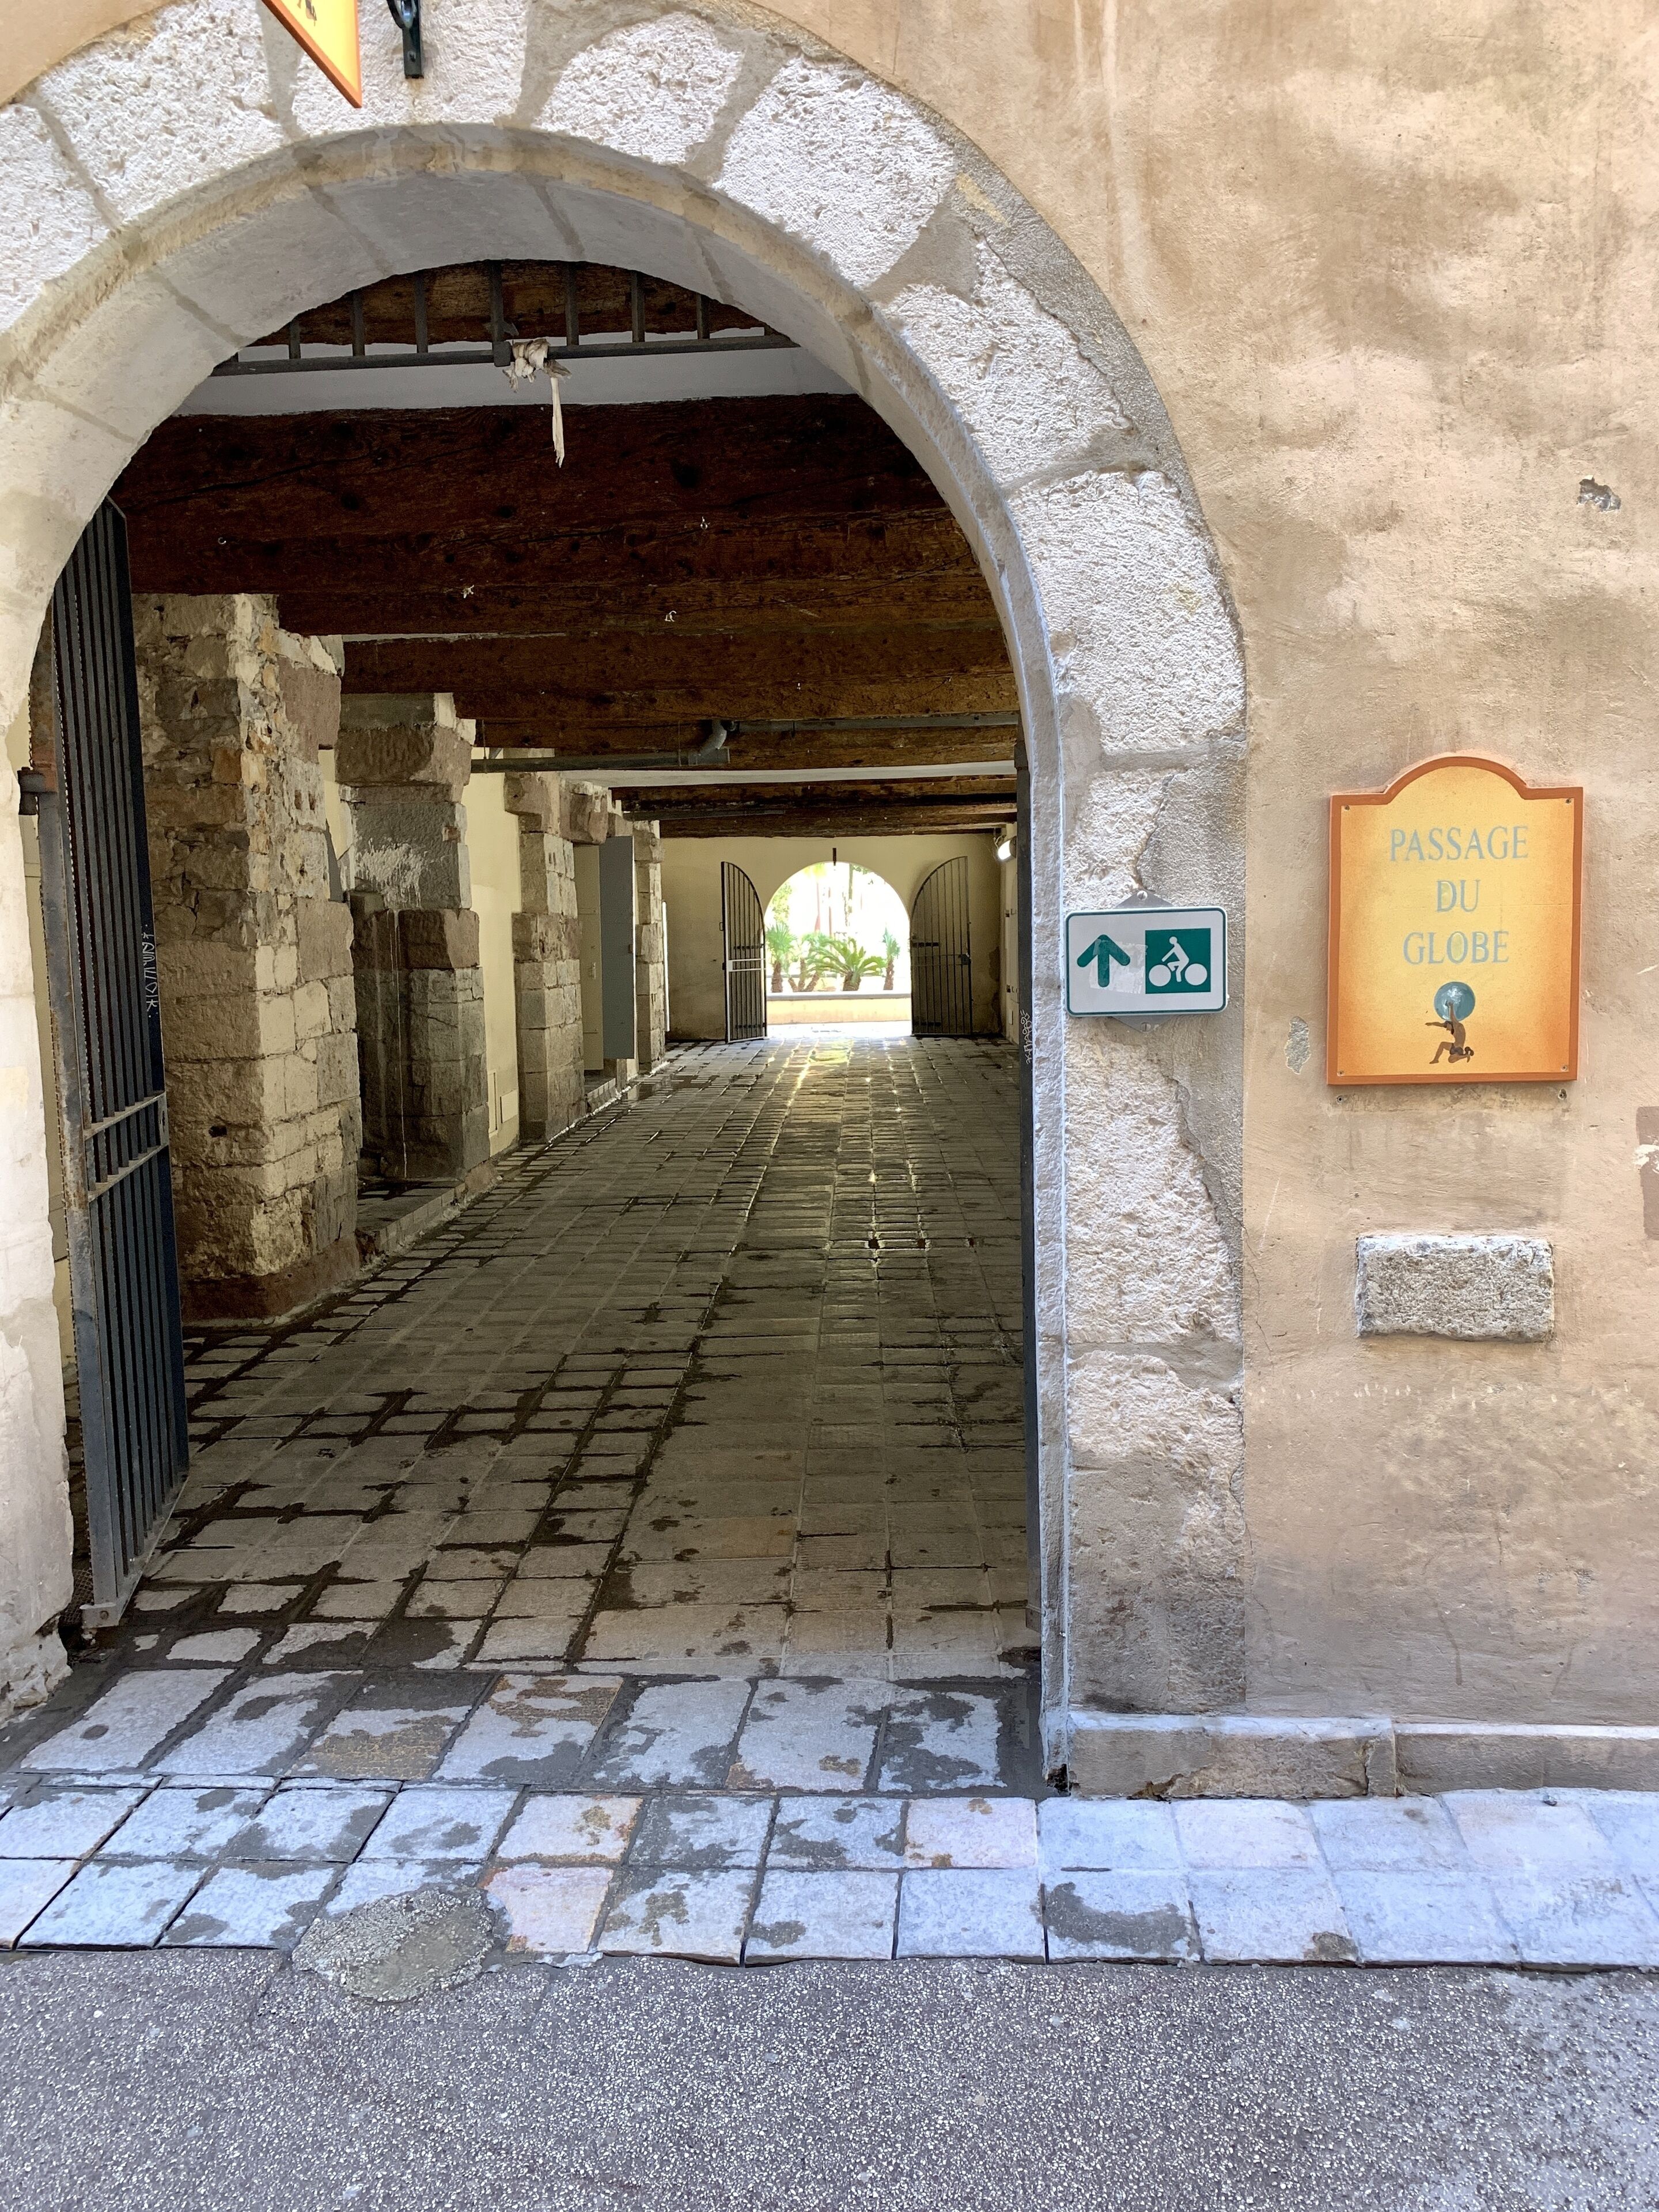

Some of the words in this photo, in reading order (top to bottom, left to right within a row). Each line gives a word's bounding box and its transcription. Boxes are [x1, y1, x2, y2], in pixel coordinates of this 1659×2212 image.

[1389, 825, 1529, 862] PASSAGE
[1435, 879, 1480, 912] DU
[1403, 931, 1510, 965] GLOBE
